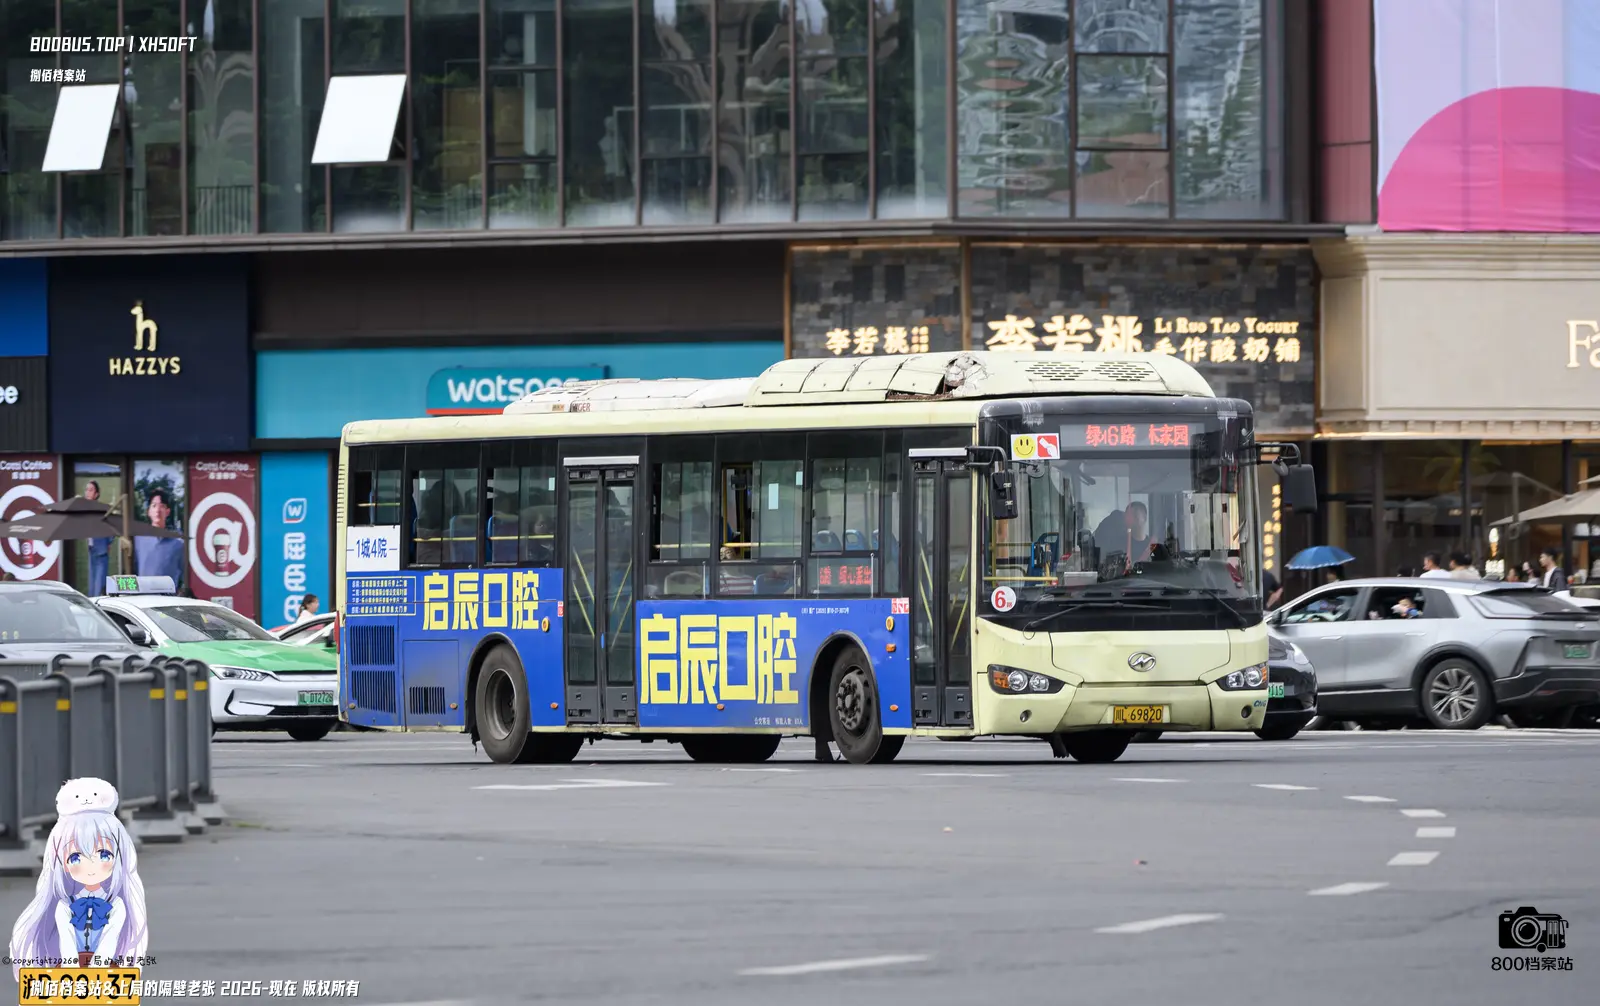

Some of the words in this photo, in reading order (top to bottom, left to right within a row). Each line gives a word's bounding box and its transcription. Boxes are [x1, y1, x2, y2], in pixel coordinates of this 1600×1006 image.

[109, 357, 181, 375] HAZZYS
[447, 374, 579, 402] watso
[422, 570, 539, 630] 启辰口腔
[640, 612, 799, 704] 启辰口腔
[1130, 708, 1162, 721] 69820
